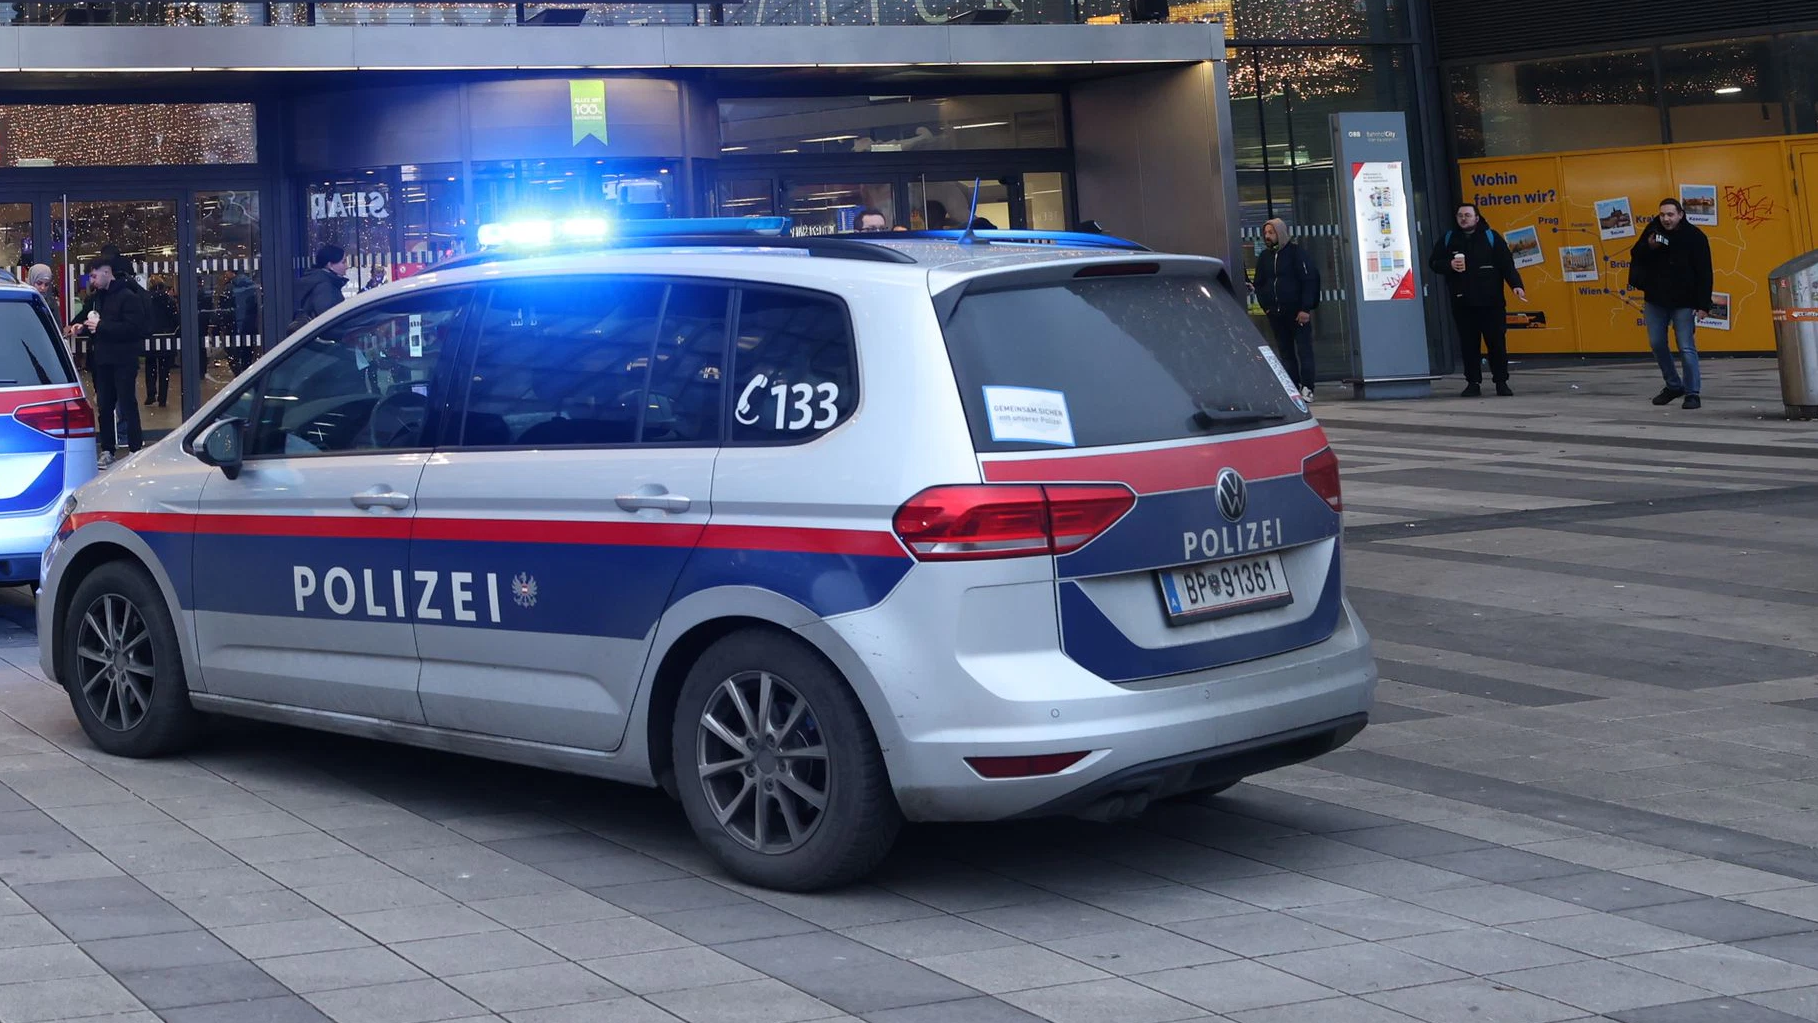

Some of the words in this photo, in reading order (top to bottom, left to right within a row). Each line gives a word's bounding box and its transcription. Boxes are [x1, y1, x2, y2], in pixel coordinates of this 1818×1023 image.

[1471, 172, 1518, 187] Wohin
[1474, 193, 1521, 207] fahren
[1524, 189, 1556, 204] wir?
[1538, 217, 1559, 225] Prag
[1579, 286, 1602, 295] Wien
[770, 381, 839, 430] 133
[1183, 518, 1282, 560] POLIZEI
[293, 565, 501, 623] POLIZEI
[1183, 571, 1207, 604] BP
[1220, 560, 1276, 597] 91361
